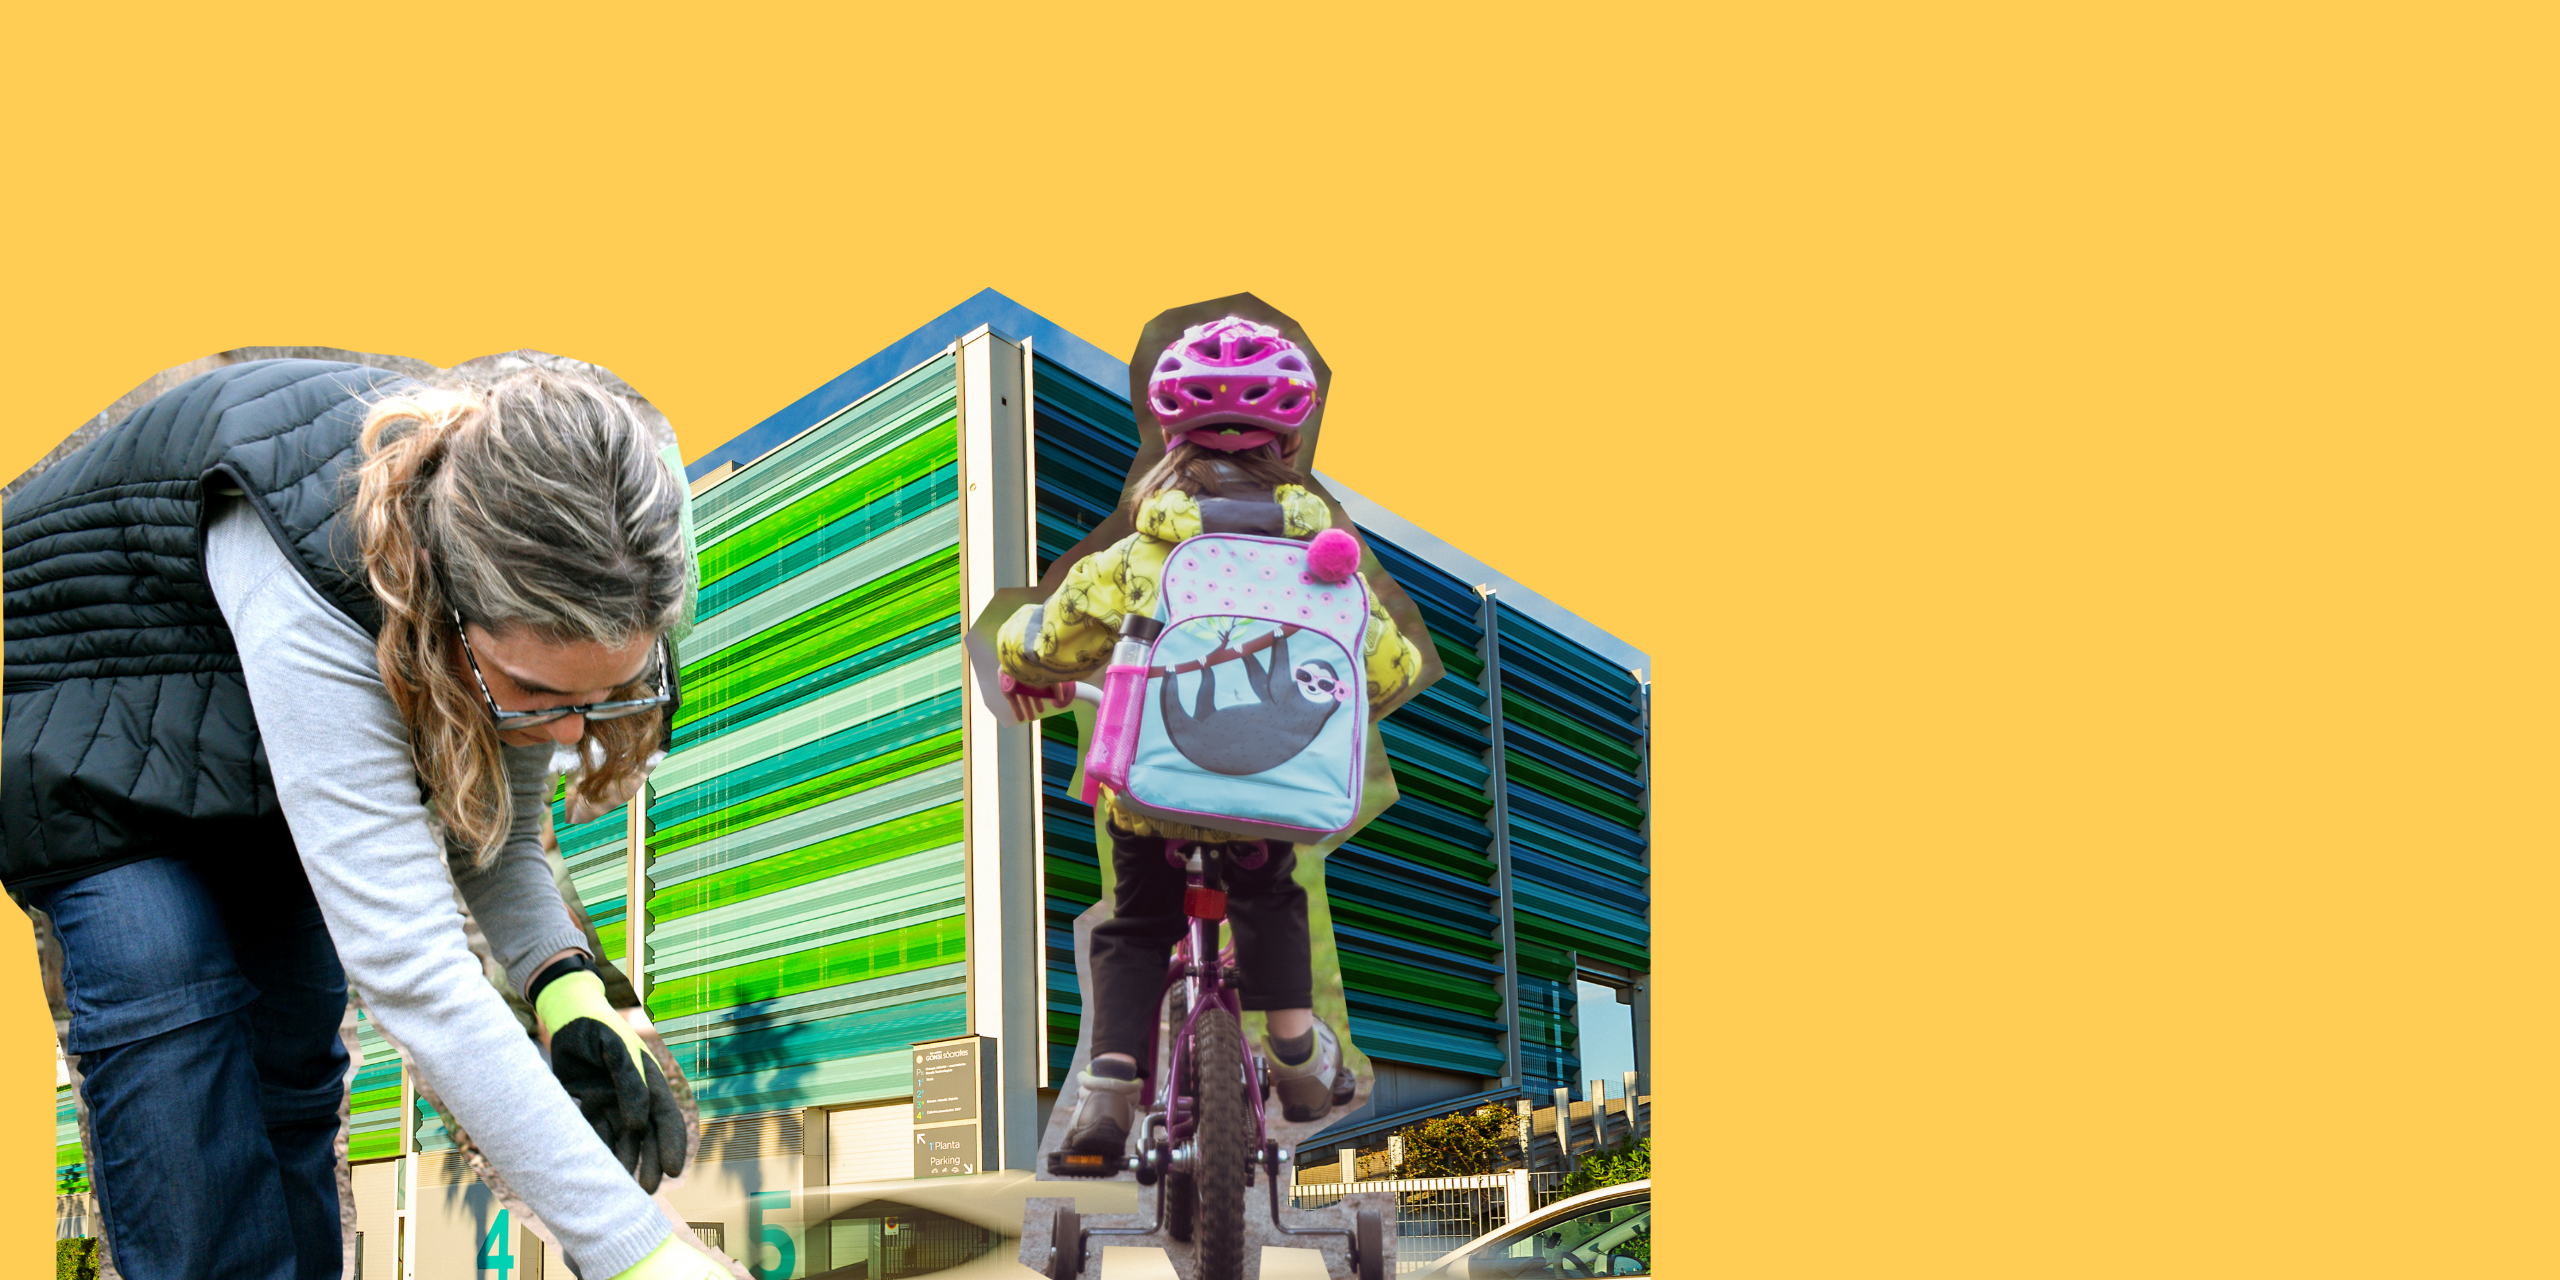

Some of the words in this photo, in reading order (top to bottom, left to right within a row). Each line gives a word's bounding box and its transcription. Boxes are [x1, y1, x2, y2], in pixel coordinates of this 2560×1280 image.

[930, 1155, 960, 1166] Parking
[935, 1141, 960, 1150] Planta
[477, 1209, 514, 1280] 4
[749, 1190, 796, 1280] 5
